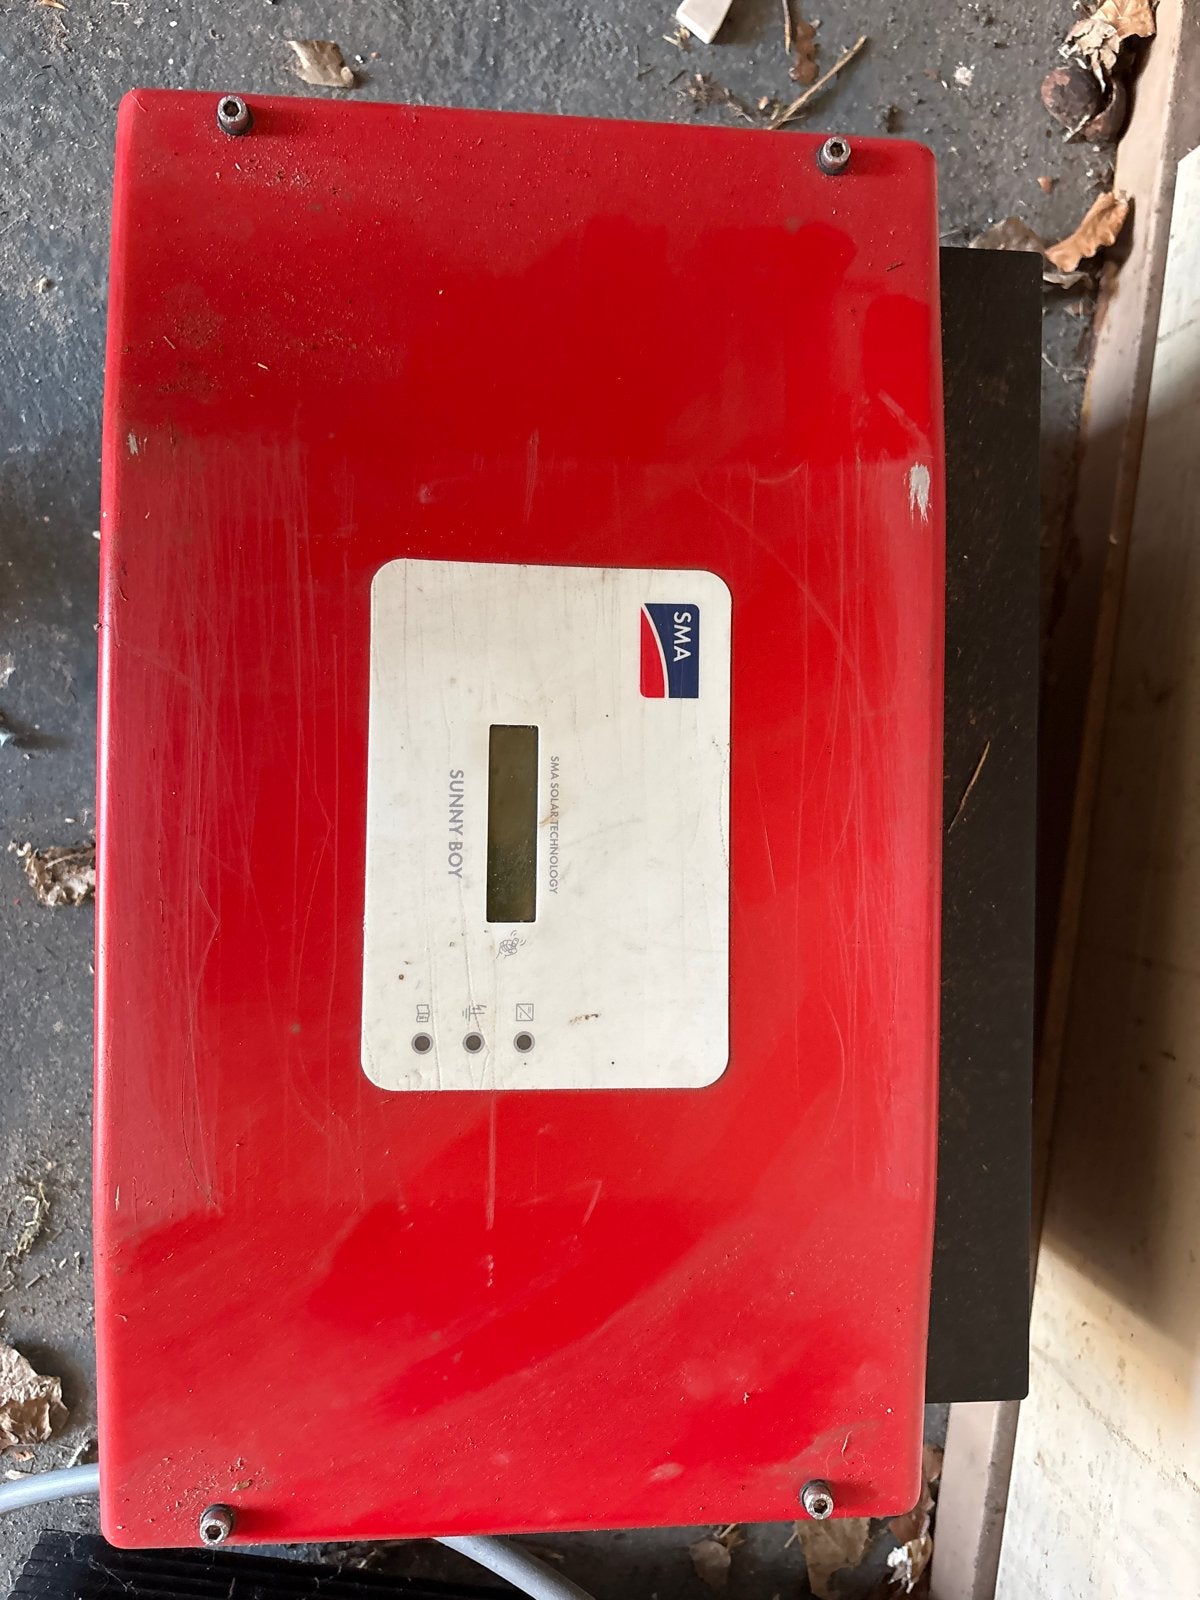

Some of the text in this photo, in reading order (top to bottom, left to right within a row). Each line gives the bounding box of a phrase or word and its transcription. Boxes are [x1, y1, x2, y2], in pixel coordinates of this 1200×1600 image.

[673, 611, 692, 663] SMA
[447, 769, 464, 879] SUNNY BOY
[548, 755, 559, 894] SMA SOLAR TECHNOLOGY
